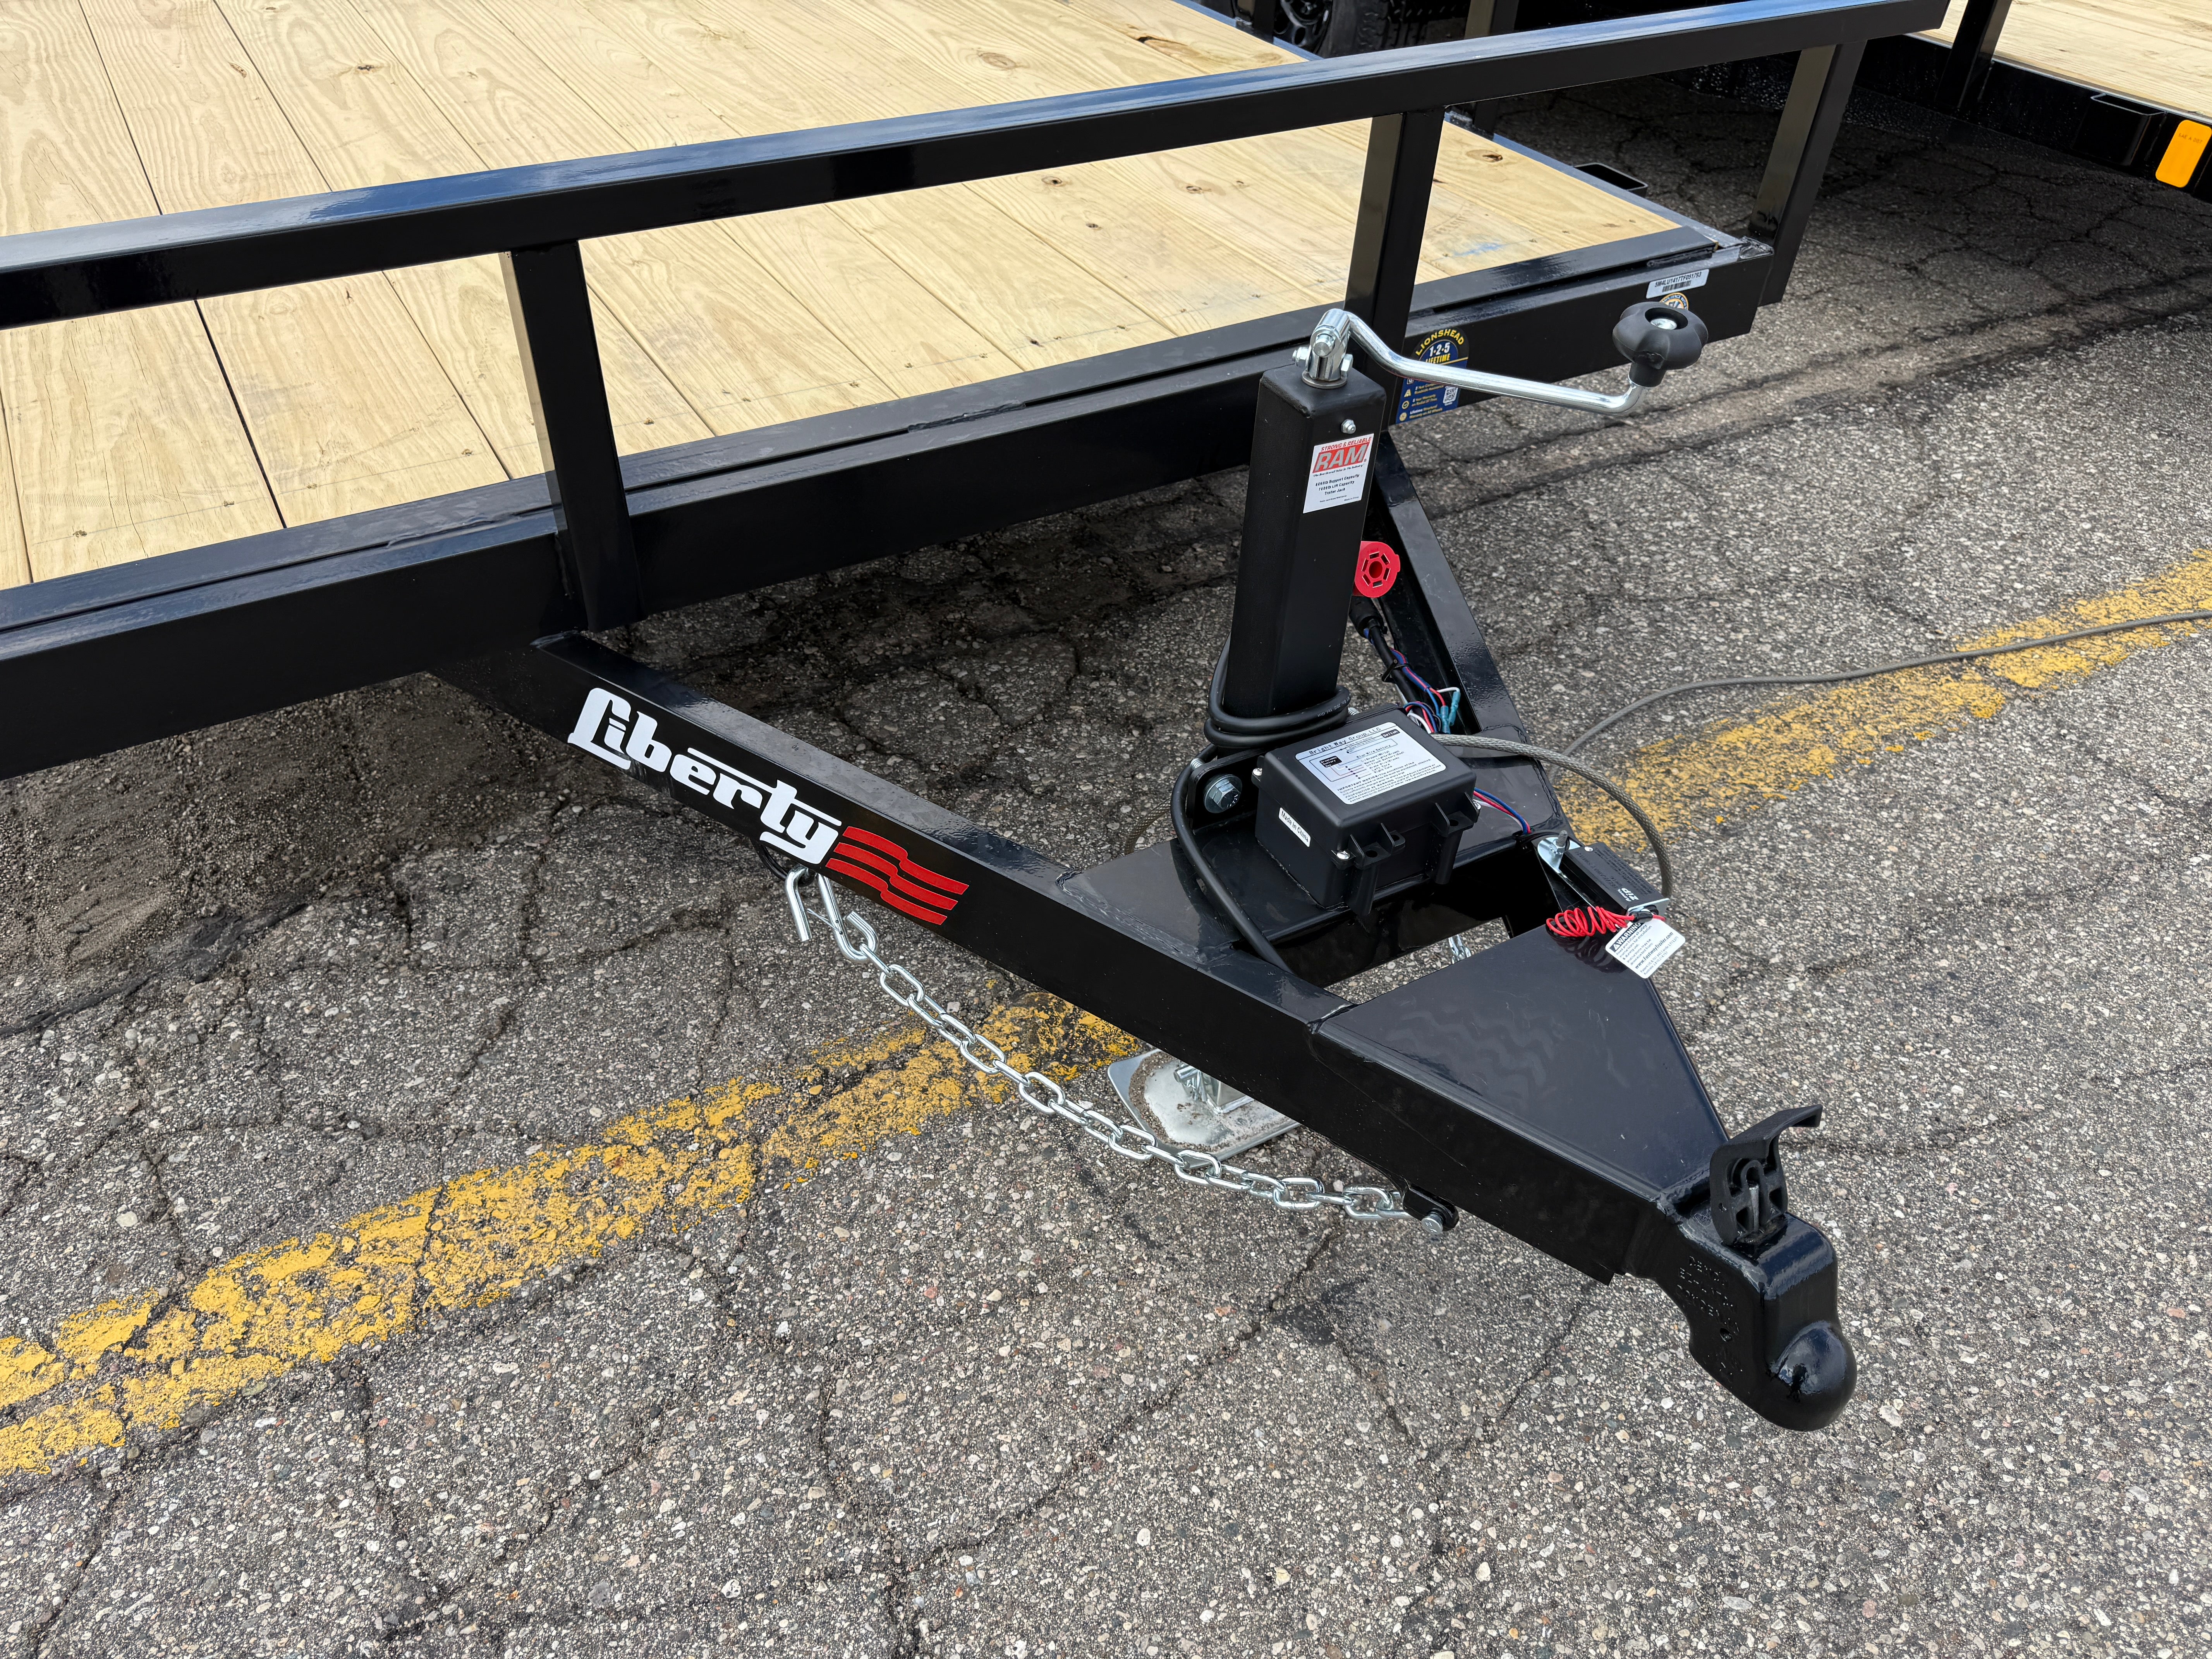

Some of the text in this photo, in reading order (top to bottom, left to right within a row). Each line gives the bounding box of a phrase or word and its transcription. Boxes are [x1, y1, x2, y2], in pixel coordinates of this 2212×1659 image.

[1416, 329, 1465, 356] LIONSHEAD
[1321, 443, 1342, 452] STRONG
[1347, 436, 1371, 446] RELIABLE
[1316, 445, 1367, 471] RAM
[1309, 745, 1333, 755] Bright
[567, 687, 842, 864] Liberty
[1281, 811, 1291, 825] Made
[1297, 827, 1308, 842] China
[1616, 923, 1640, 945] WARNING
